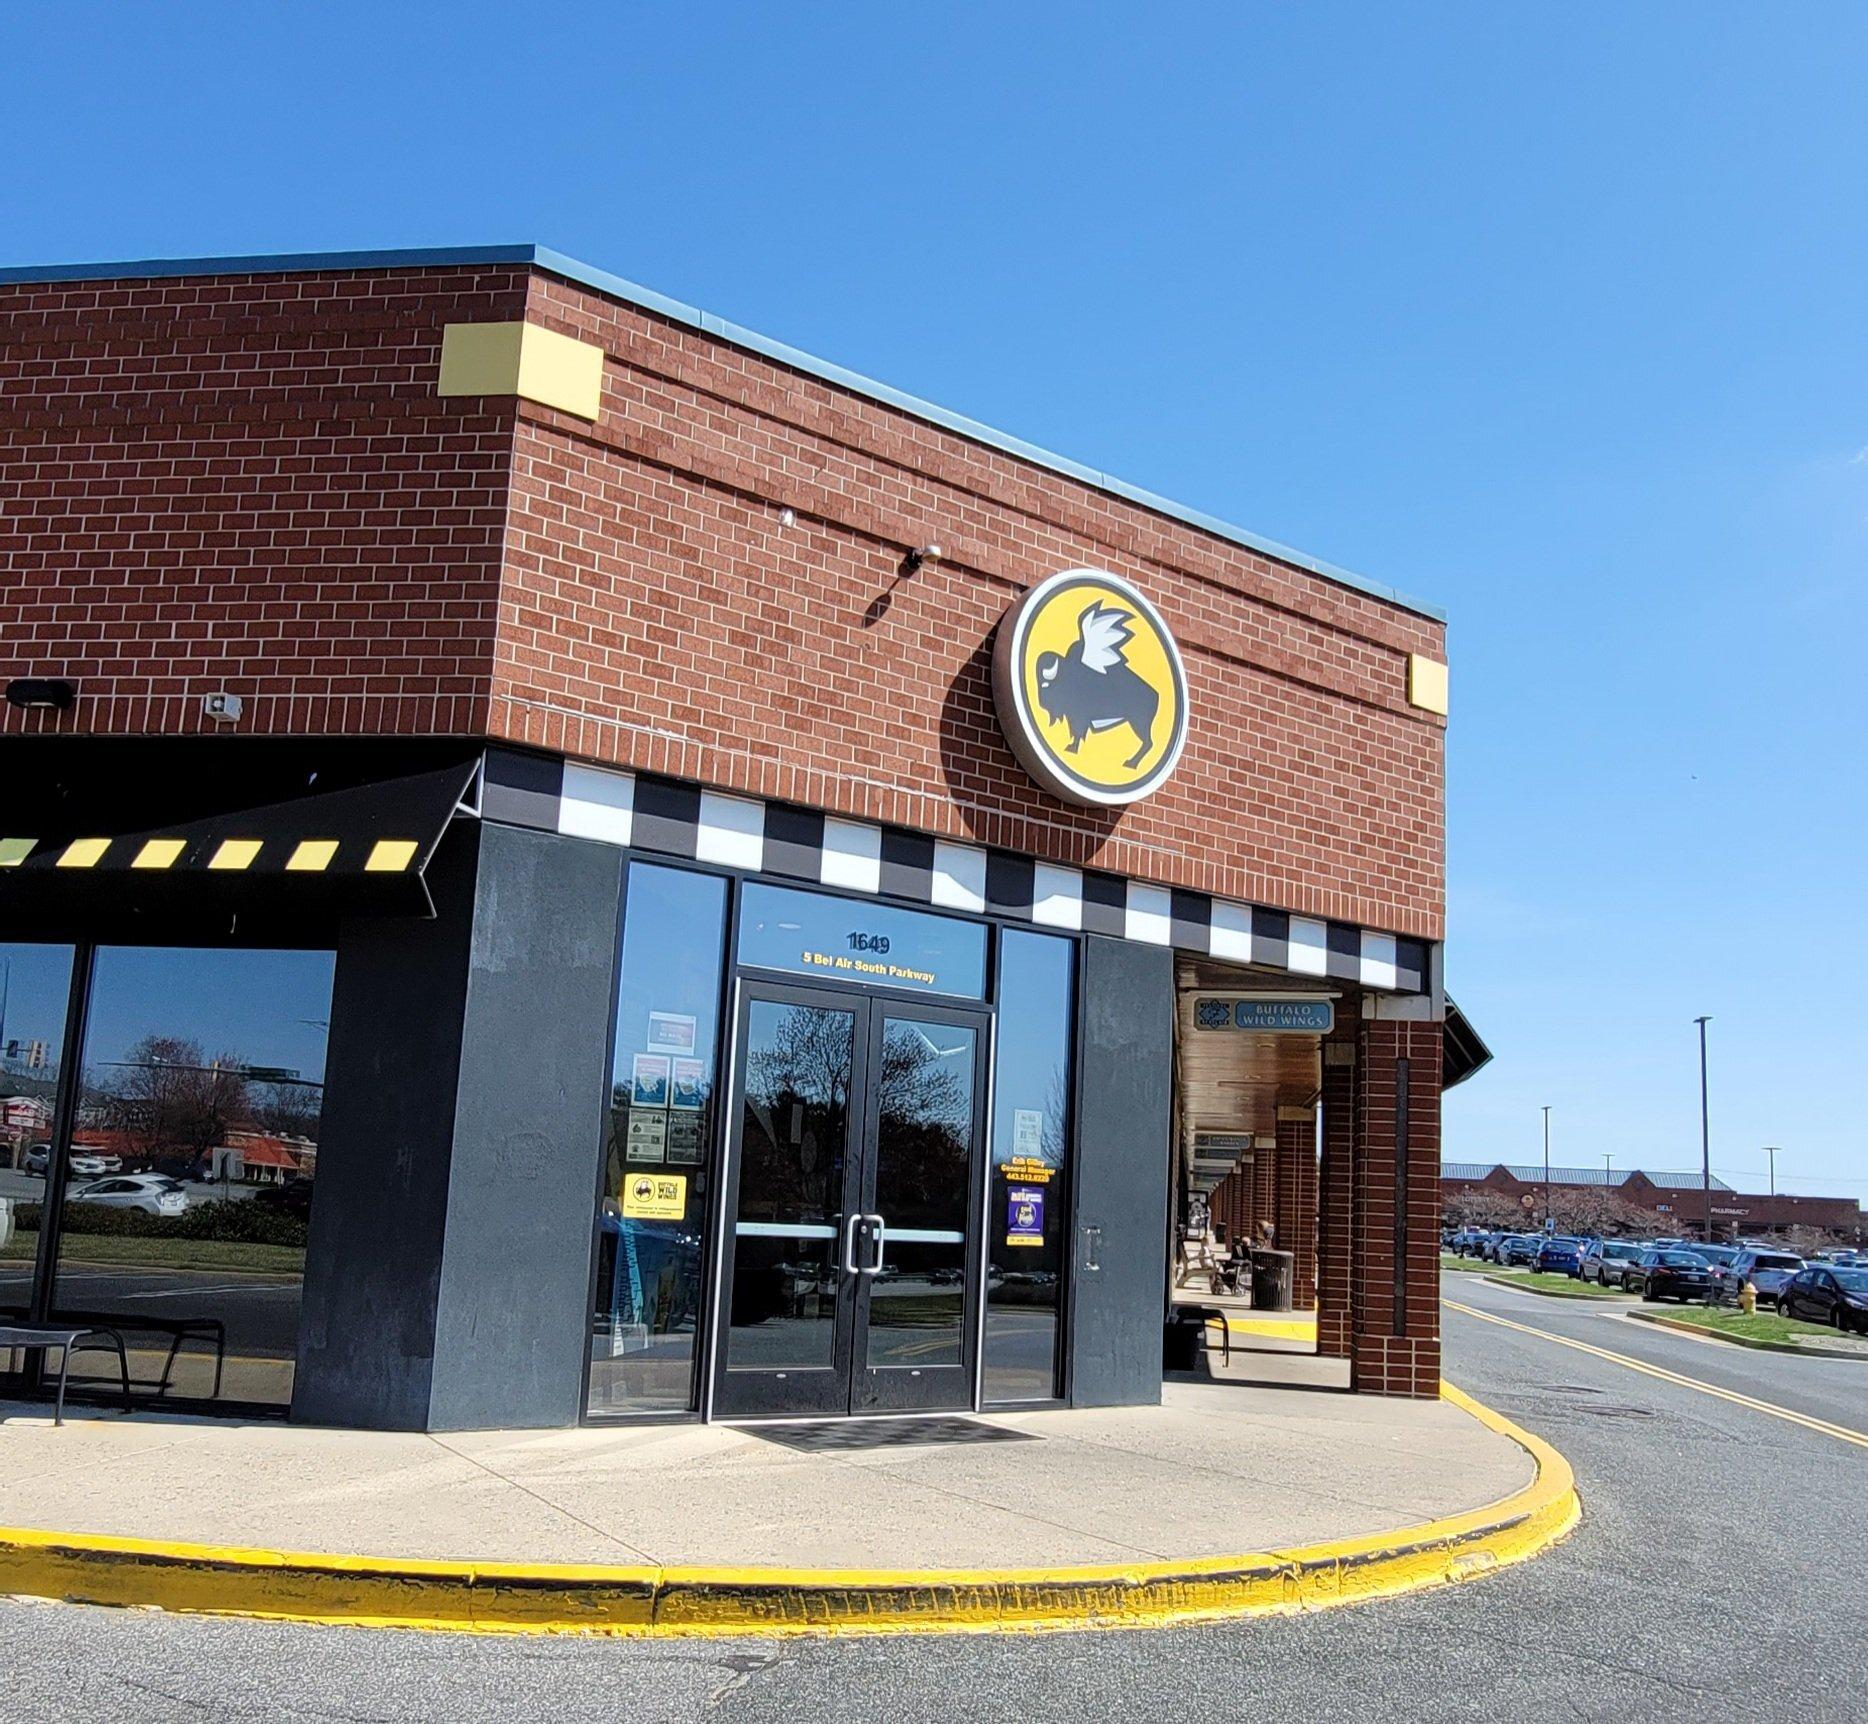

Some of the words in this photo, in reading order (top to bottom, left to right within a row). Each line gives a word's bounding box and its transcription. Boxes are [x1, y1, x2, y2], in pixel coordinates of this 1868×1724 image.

[847, 931, 890, 954] 1649
[803, 952, 812, 963] 5
[814, 954, 833, 967] Bel
[835, 957, 852, 970] Air
[854, 960, 888, 975] South
[889, 965, 936, 985] Parkway
[1256, 1004, 1311, 1015] BUFFALO
[1243, 1015, 1276, 1026] WILD
[1281, 1016, 1323, 1026] WINGS
[658, 1187, 678, 1195] WILD
[1656, 1204, 1673, 1212] DELI
[1710, 1206, 1750, 1216] PHARMACY
